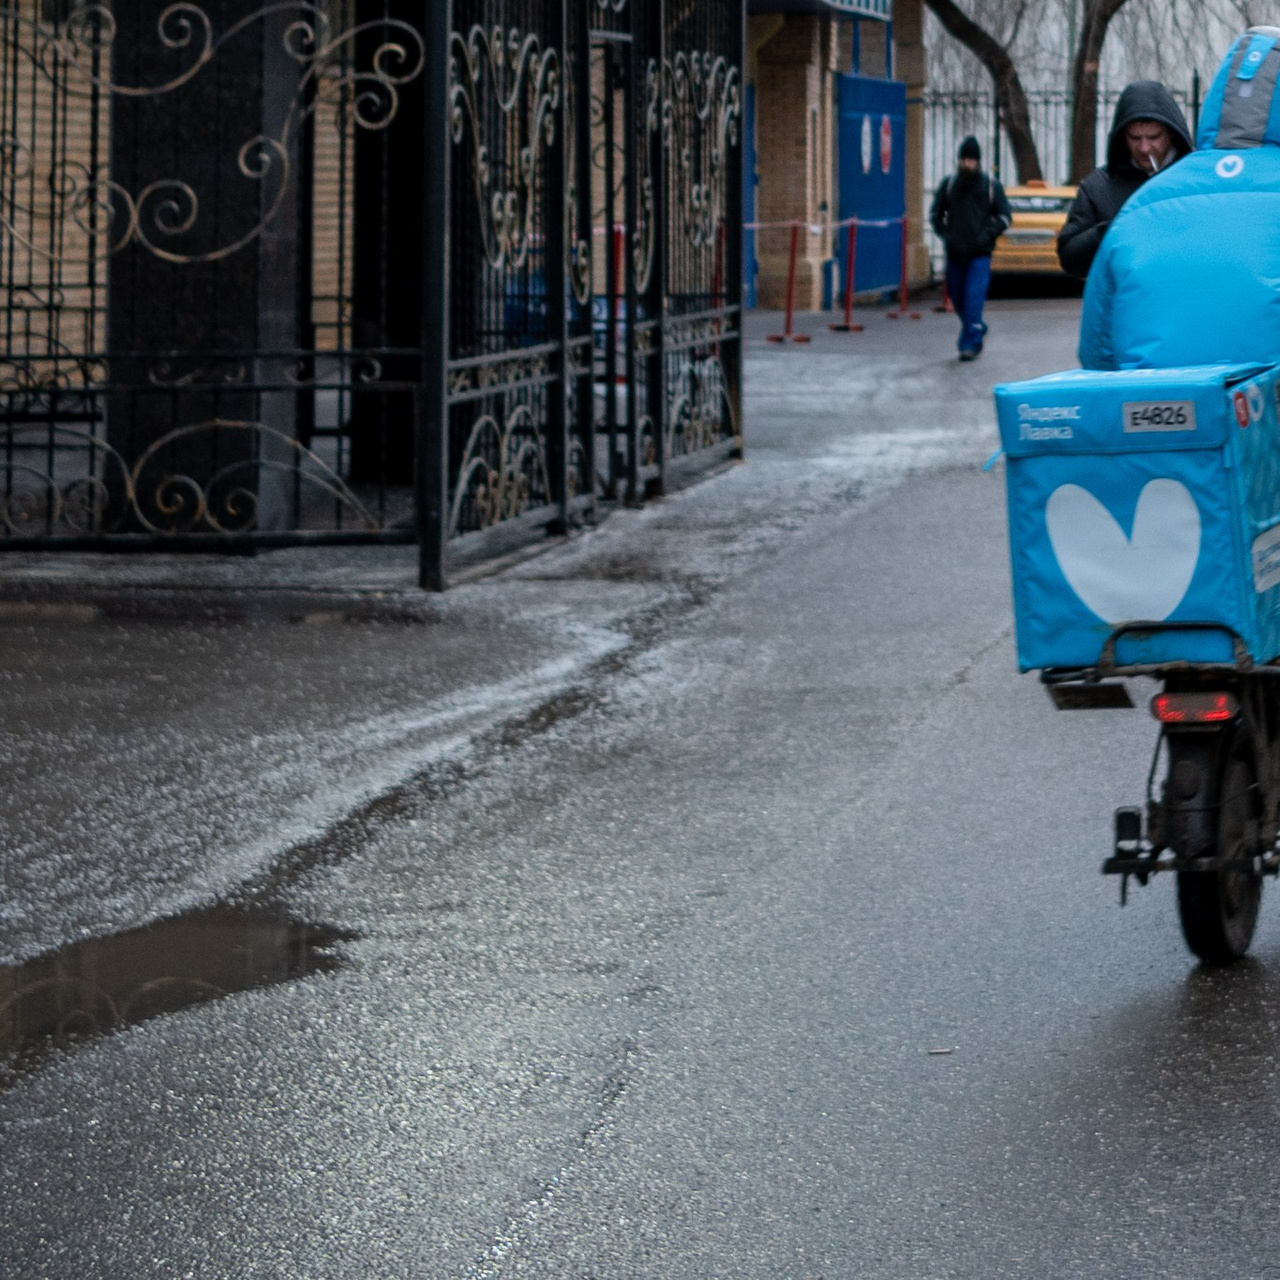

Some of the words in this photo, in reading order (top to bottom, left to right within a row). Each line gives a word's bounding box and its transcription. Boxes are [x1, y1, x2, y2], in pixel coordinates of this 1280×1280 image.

[1017, 403, 1081, 422] Яндекс
[1130, 406, 1188, 426] E4826
[1019, 423, 1074, 440] Лавка
